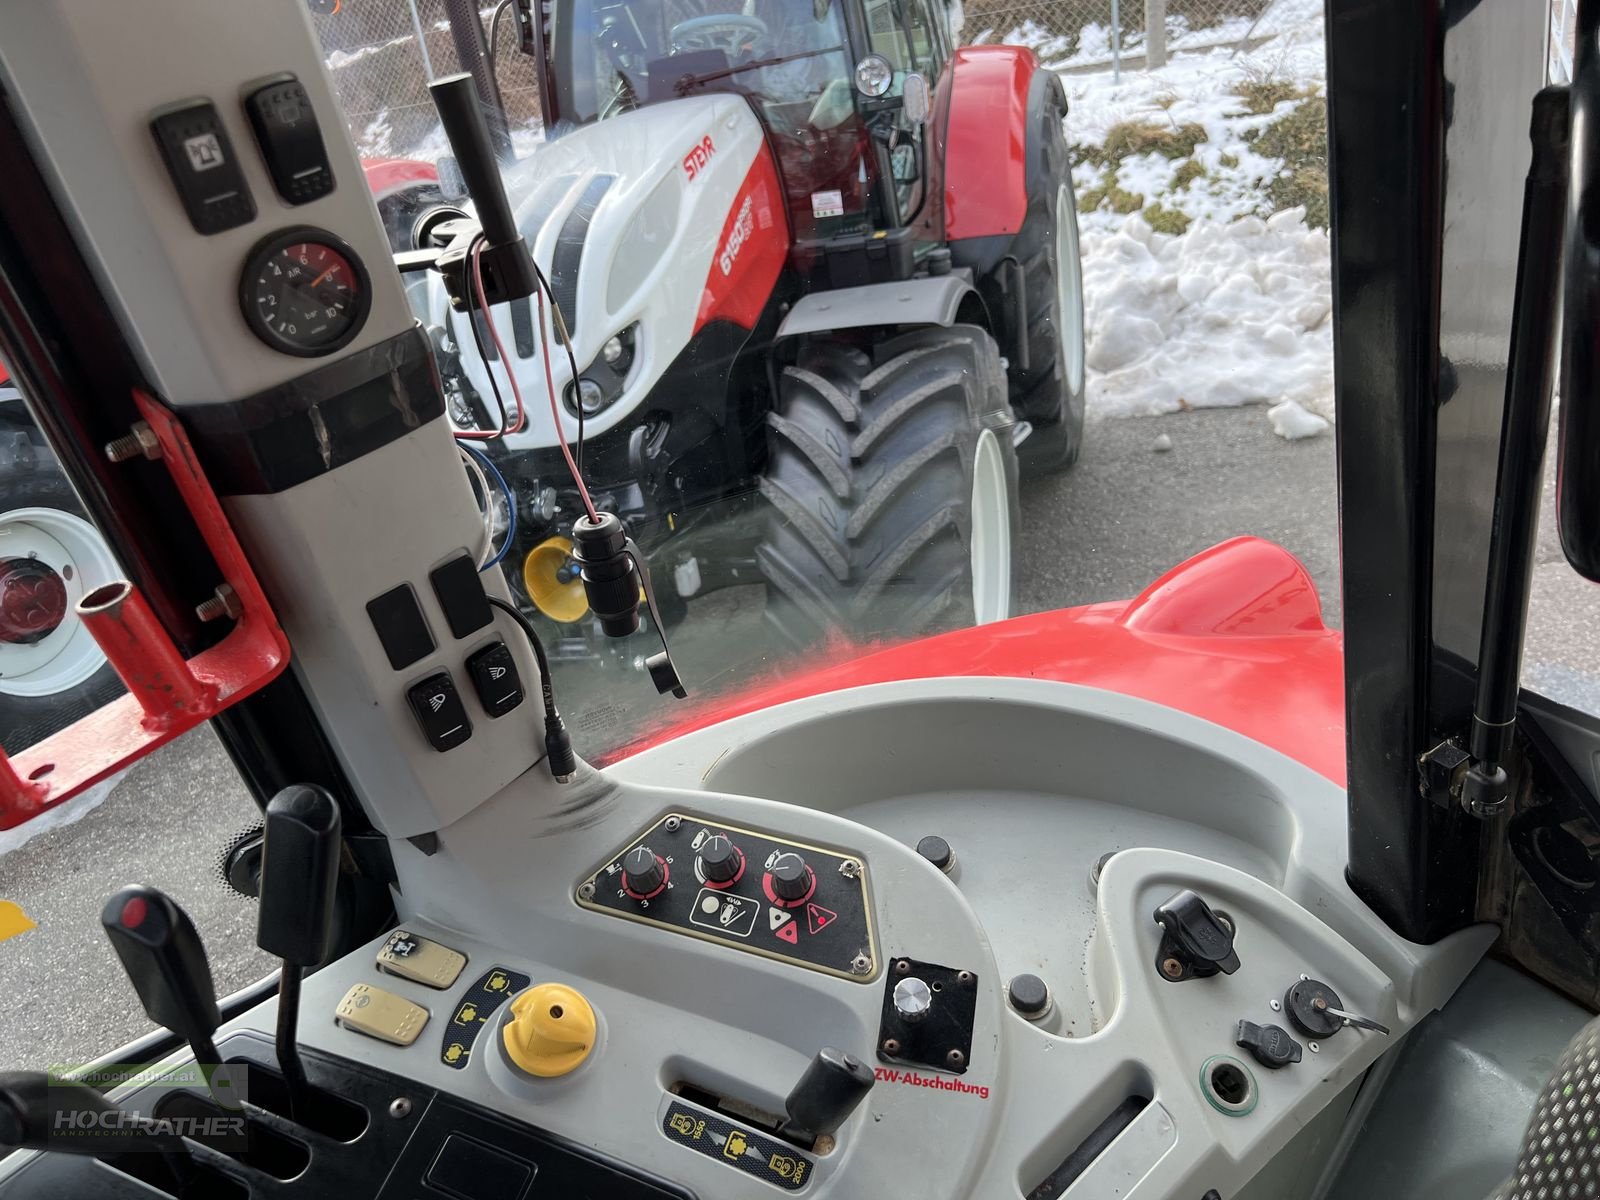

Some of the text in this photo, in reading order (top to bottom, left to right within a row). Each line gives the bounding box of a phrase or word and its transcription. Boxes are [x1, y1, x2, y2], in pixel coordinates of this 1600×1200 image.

[682, 135, 717, 182] STEYR
[720, 221, 745, 276] 6150
[300, 255, 308, 265] 6
[274, 266, 282, 276] 4
[288, 267, 301, 278] AIR
[268, 295, 277, 306] 2
[304, 310, 318, 320] bar
[326, 308, 337, 319] 10
[288, 324, 297, 334] 0
[666, 855, 674, 864] 5
[667, 881, 674, 890] 4
[617, 889, 625, 898] 2
[641, 899, 649, 908] 3
[874, 1067, 989, 1099] ZW-Abschaltung
[693, 1120, 706, 1141] 1550
[792, 1161, 806, 1185] 2000
